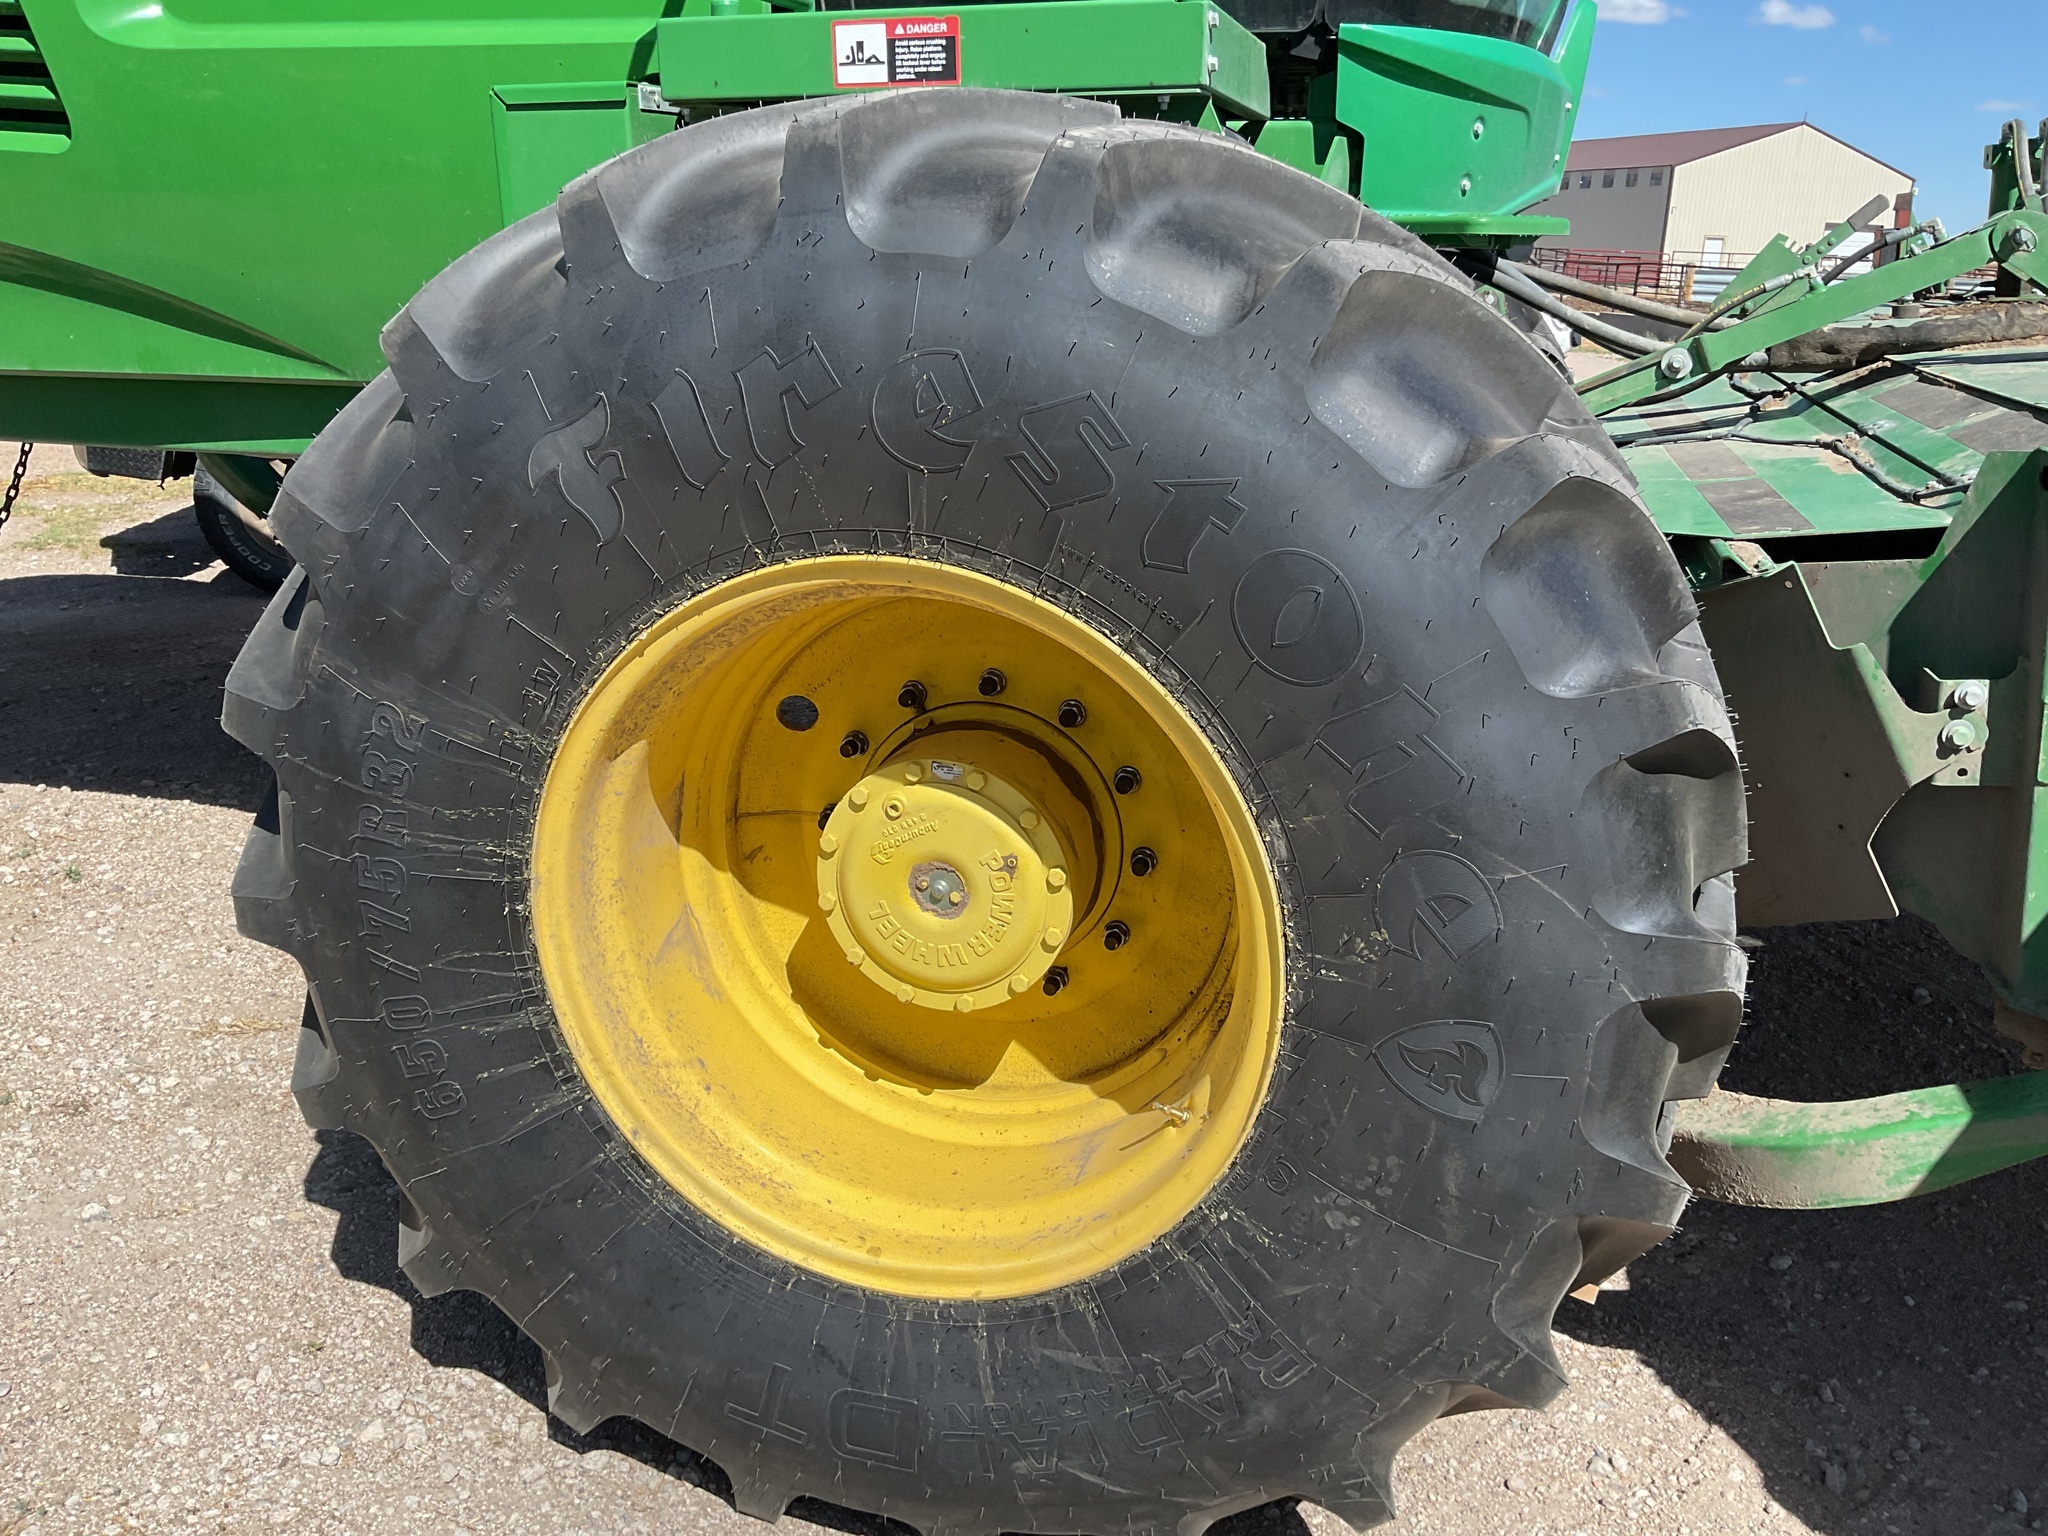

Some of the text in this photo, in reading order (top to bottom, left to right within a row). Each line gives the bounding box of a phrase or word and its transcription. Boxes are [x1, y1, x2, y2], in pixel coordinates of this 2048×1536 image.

[906, 23, 948, 34] DANGER
[218, 513, 272, 571] COOPER
[358, 701, 467, 1120] 650/75R32
[868, 849, 1016, 968] POWER WHEEL
[725, 1329, 1317, 1478] RADIAL DT
[947, 1311, 1260, 1429] ALL TRACTION
